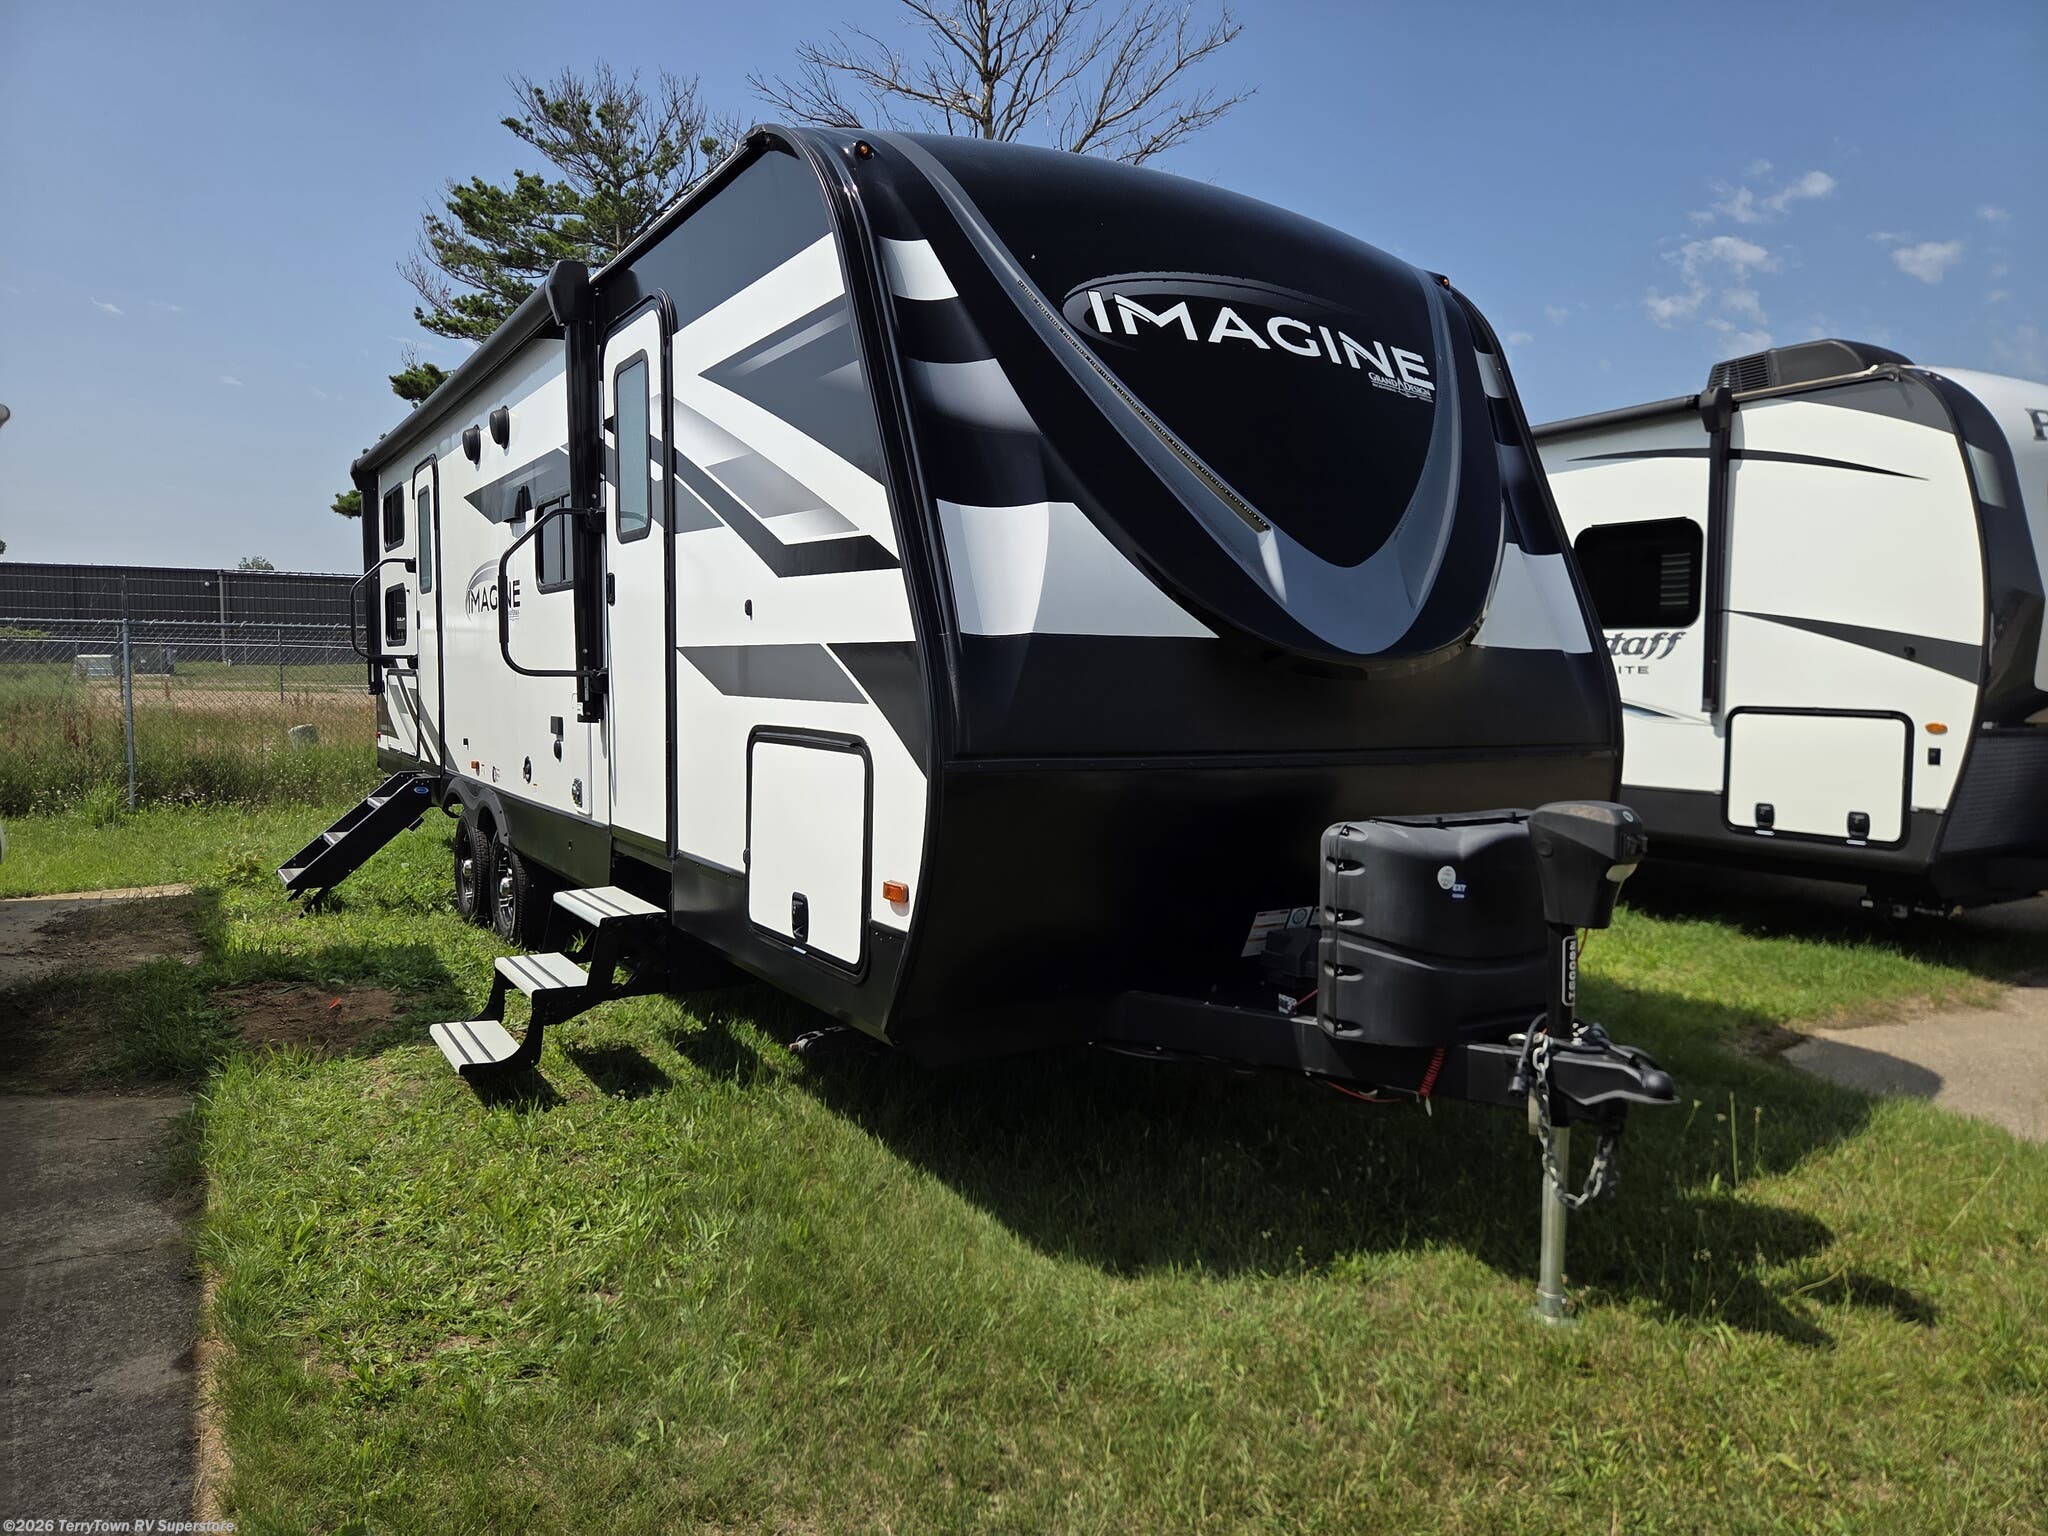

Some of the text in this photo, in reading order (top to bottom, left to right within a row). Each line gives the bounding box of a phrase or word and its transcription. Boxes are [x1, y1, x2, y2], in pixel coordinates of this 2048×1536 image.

[1086, 289, 1436, 392] IMAGINE
[467, 579, 521, 615] IMAGE
[1605, 631, 1688, 660] taff
[1618, 665, 1650, 675] ITE
